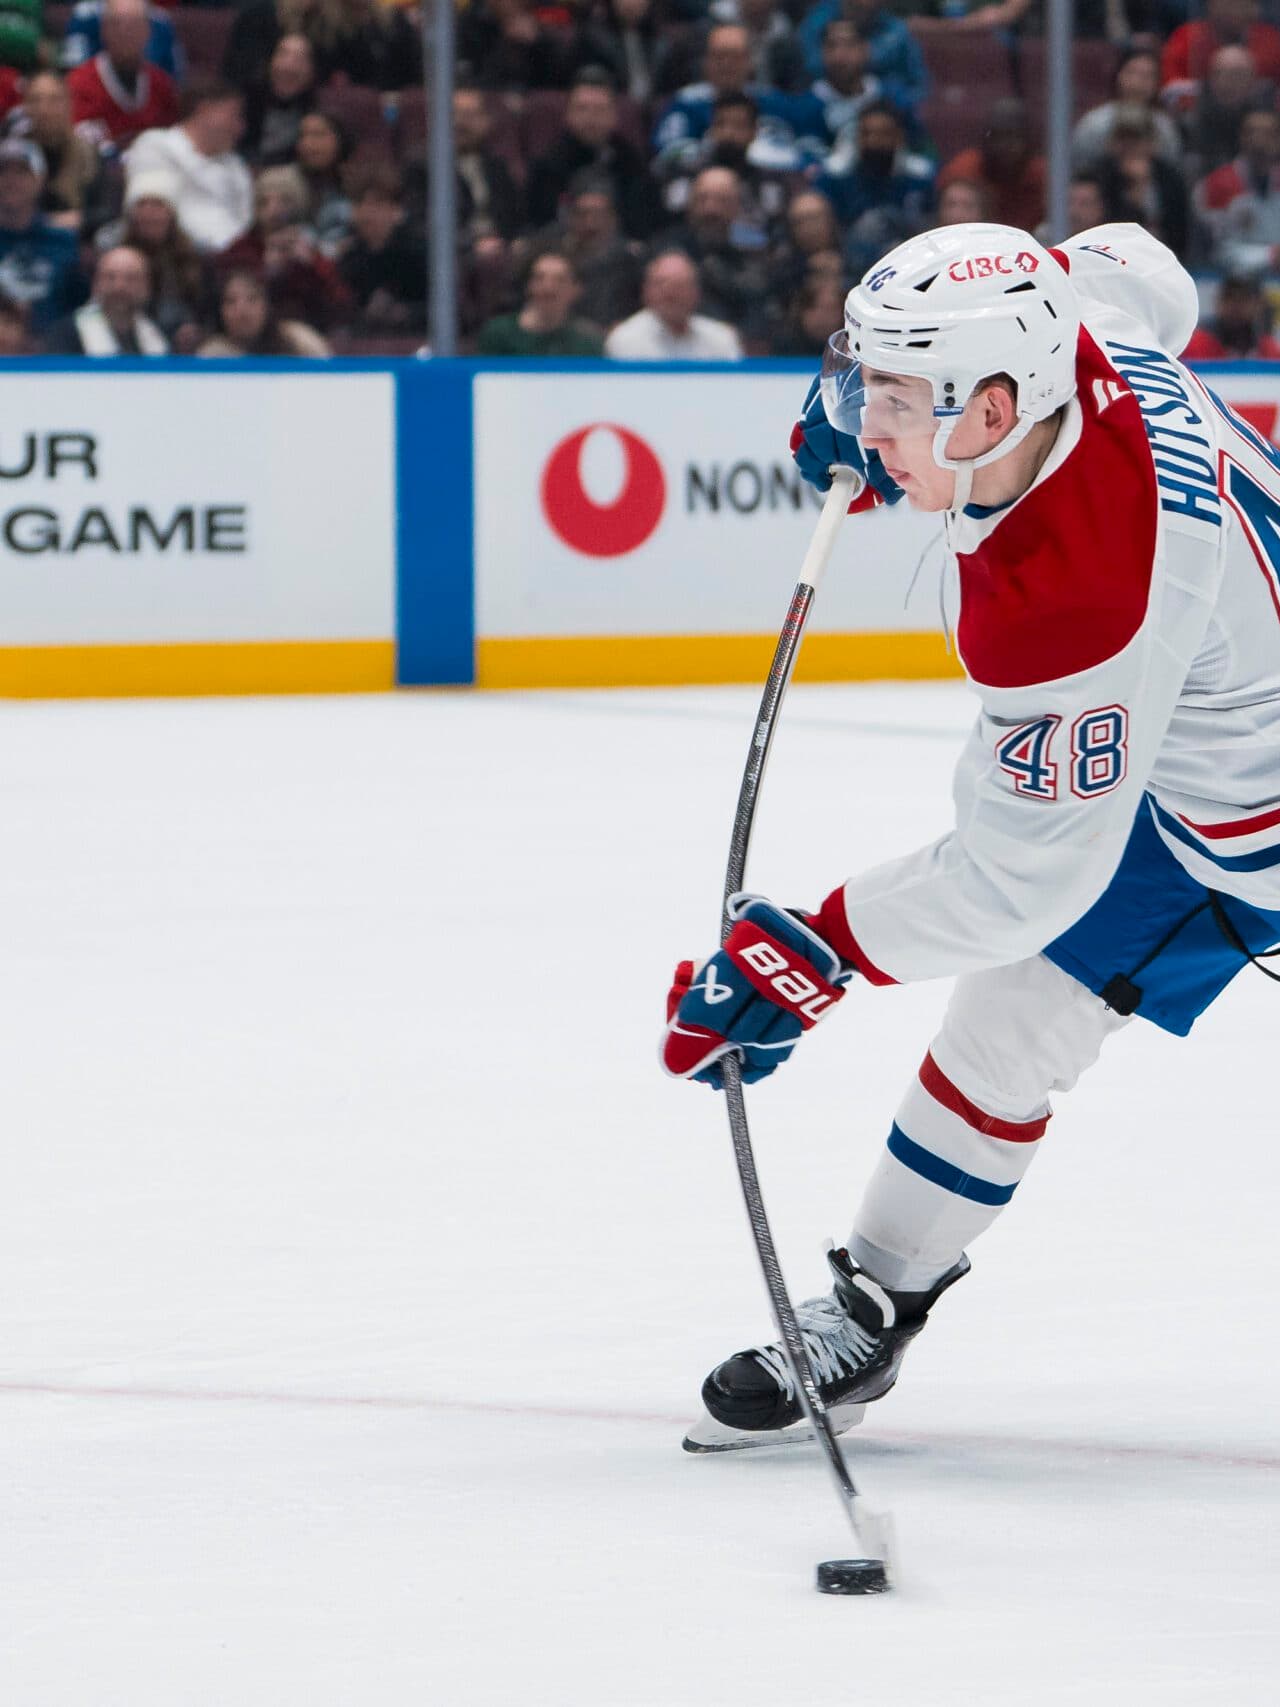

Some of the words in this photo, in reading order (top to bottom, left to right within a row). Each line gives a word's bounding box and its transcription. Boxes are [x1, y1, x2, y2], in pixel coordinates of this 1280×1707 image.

[949, 256, 1013, 282] CIBC
[1105, 340, 1223, 527] HUTSON
[685, 460, 826, 514] NON
[4, 506, 246, 553] GAME
[995, 703, 1129, 801] 48
